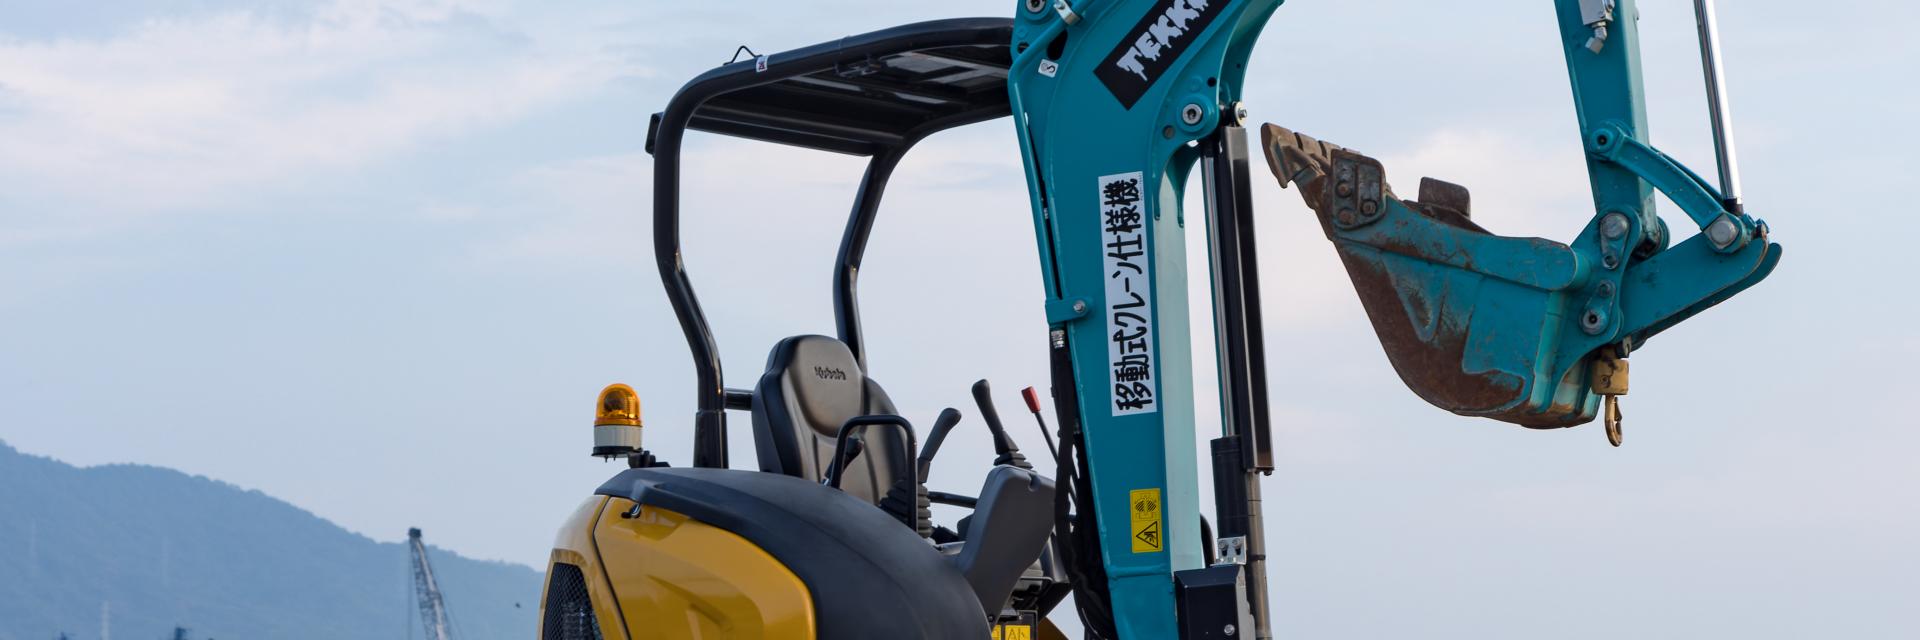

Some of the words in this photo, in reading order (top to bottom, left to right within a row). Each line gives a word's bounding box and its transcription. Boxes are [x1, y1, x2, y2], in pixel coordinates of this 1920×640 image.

[1103, 178, 1153, 411] 移動式クレーン仕様機
